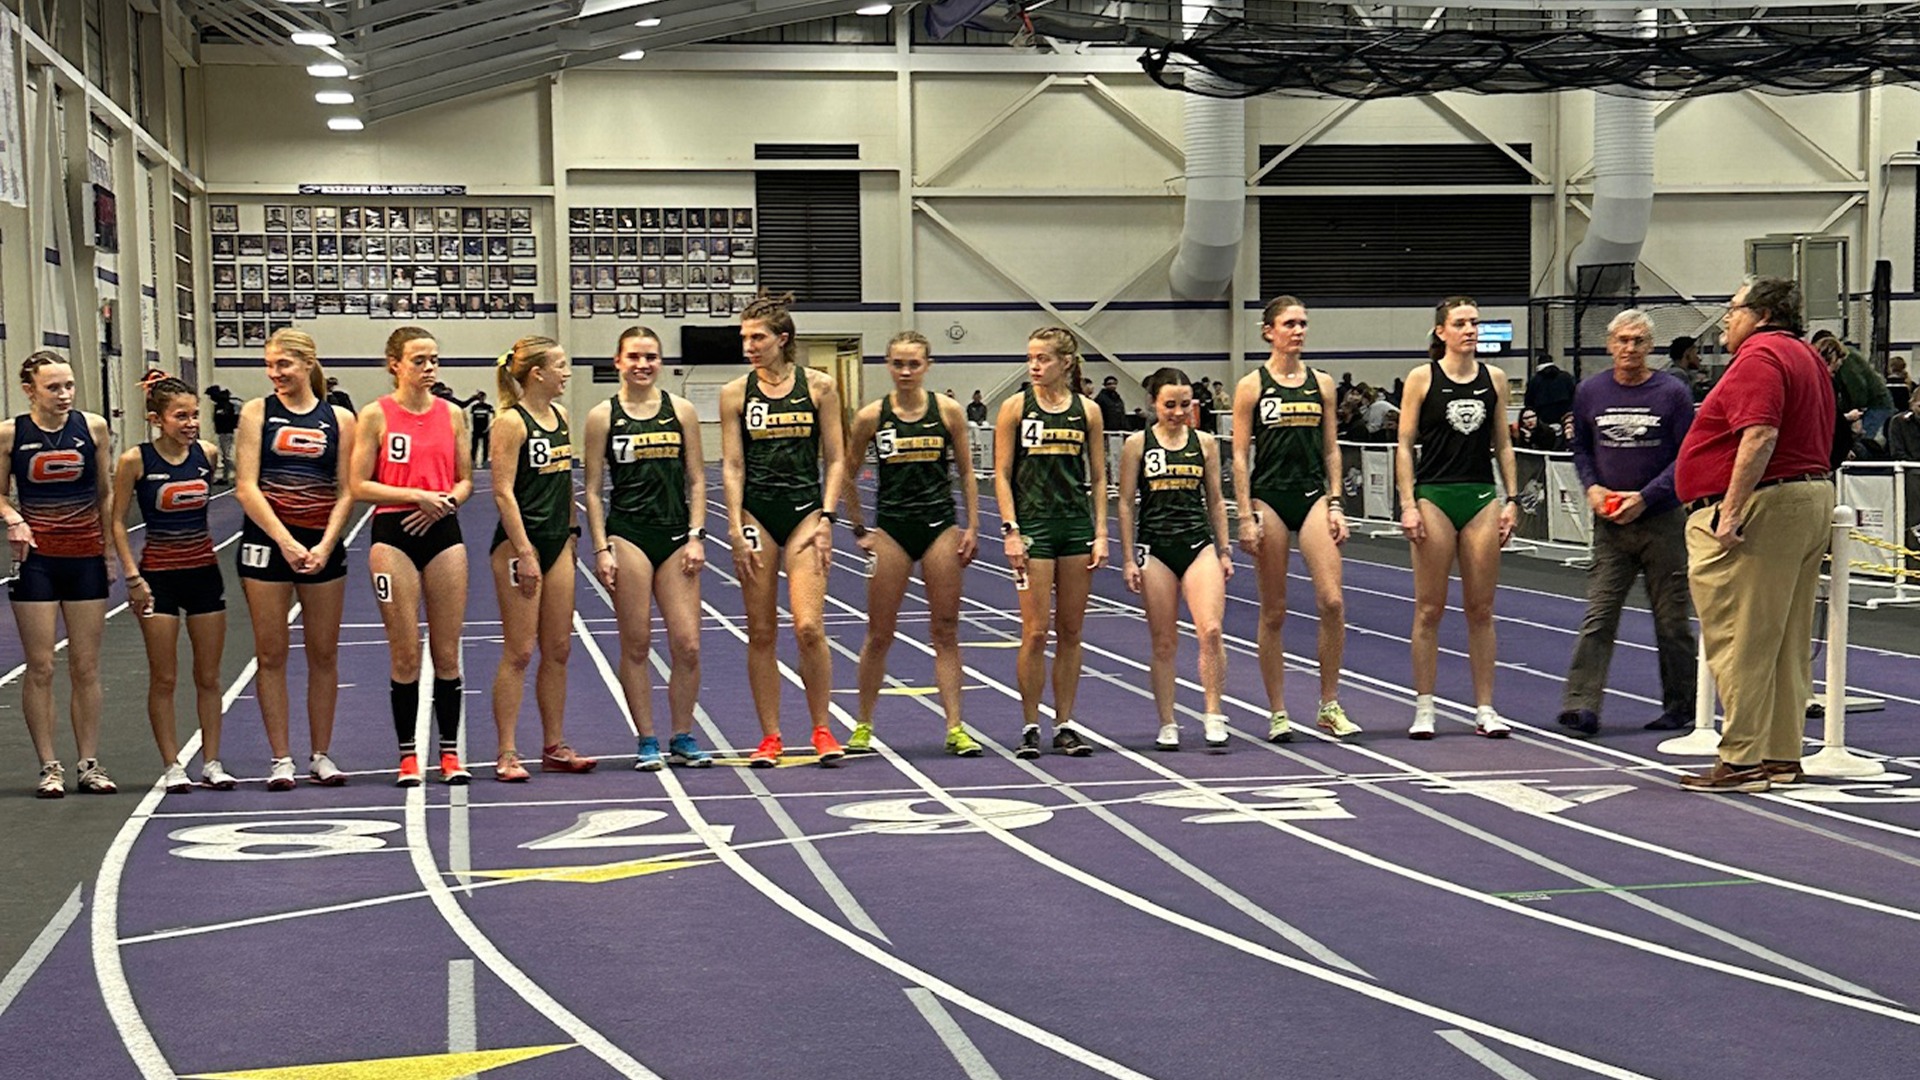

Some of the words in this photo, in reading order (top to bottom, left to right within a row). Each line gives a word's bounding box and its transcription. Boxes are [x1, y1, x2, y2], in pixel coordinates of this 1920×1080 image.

[750, 405, 763, 427] 6
[1264, 400, 1279, 421] 2
[272, 425, 328, 458] C
[881, 432, 894, 455] 5
[1025, 422, 1039, 445] 4
[391, 435, 407, 460] 9
[533, 441, 548, 465] 8
[616, 437, 630, 461] 7
[28, 449, 85, 483] C
[1148, 452, 1161, 473] 3
[156, 479, 210, 513] C
[243, 545, 264, 566] 11
[375, 574, 389, 600] 9
[1136, 786, 1356, 824] 5
[1410, 779, 1638, 814] 4
[168, 819, 402, 861] 8
[517, 809, 735, 850] 7
